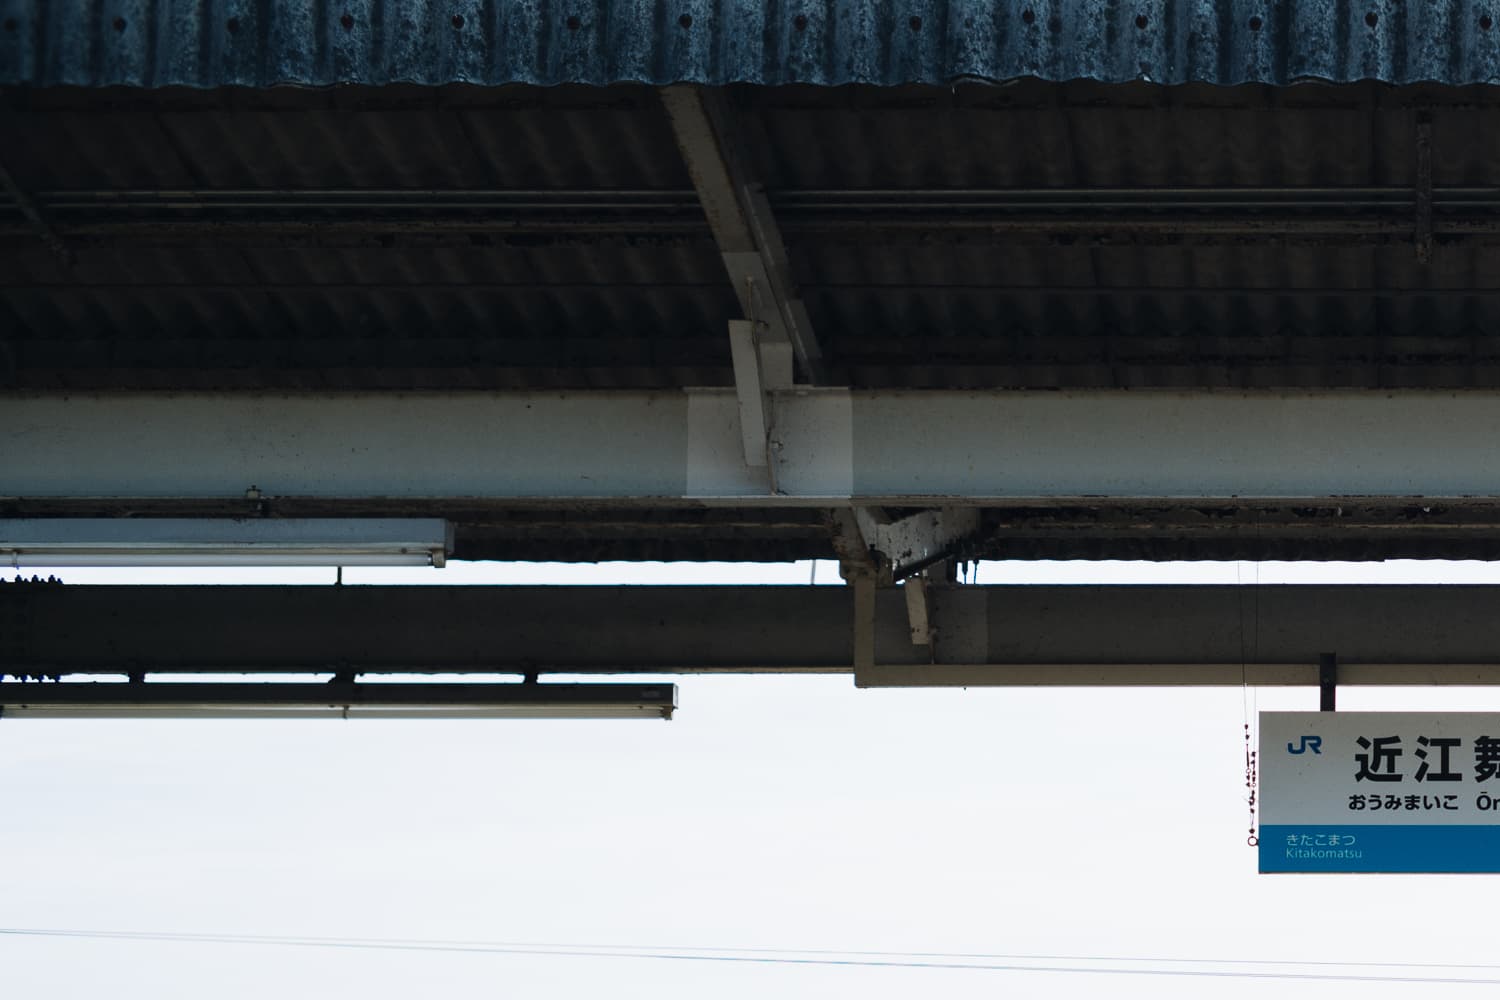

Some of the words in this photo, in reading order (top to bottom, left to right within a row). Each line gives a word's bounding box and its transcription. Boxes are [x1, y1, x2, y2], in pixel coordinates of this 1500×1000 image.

[1287, 735, 1322, 755] JR
[1348, 794, 1459, 811] おうみまいこ
[1286, 834, 1356, 846] きたこまつ
[1286, 848, 1362, 859] Kitakomatsu
